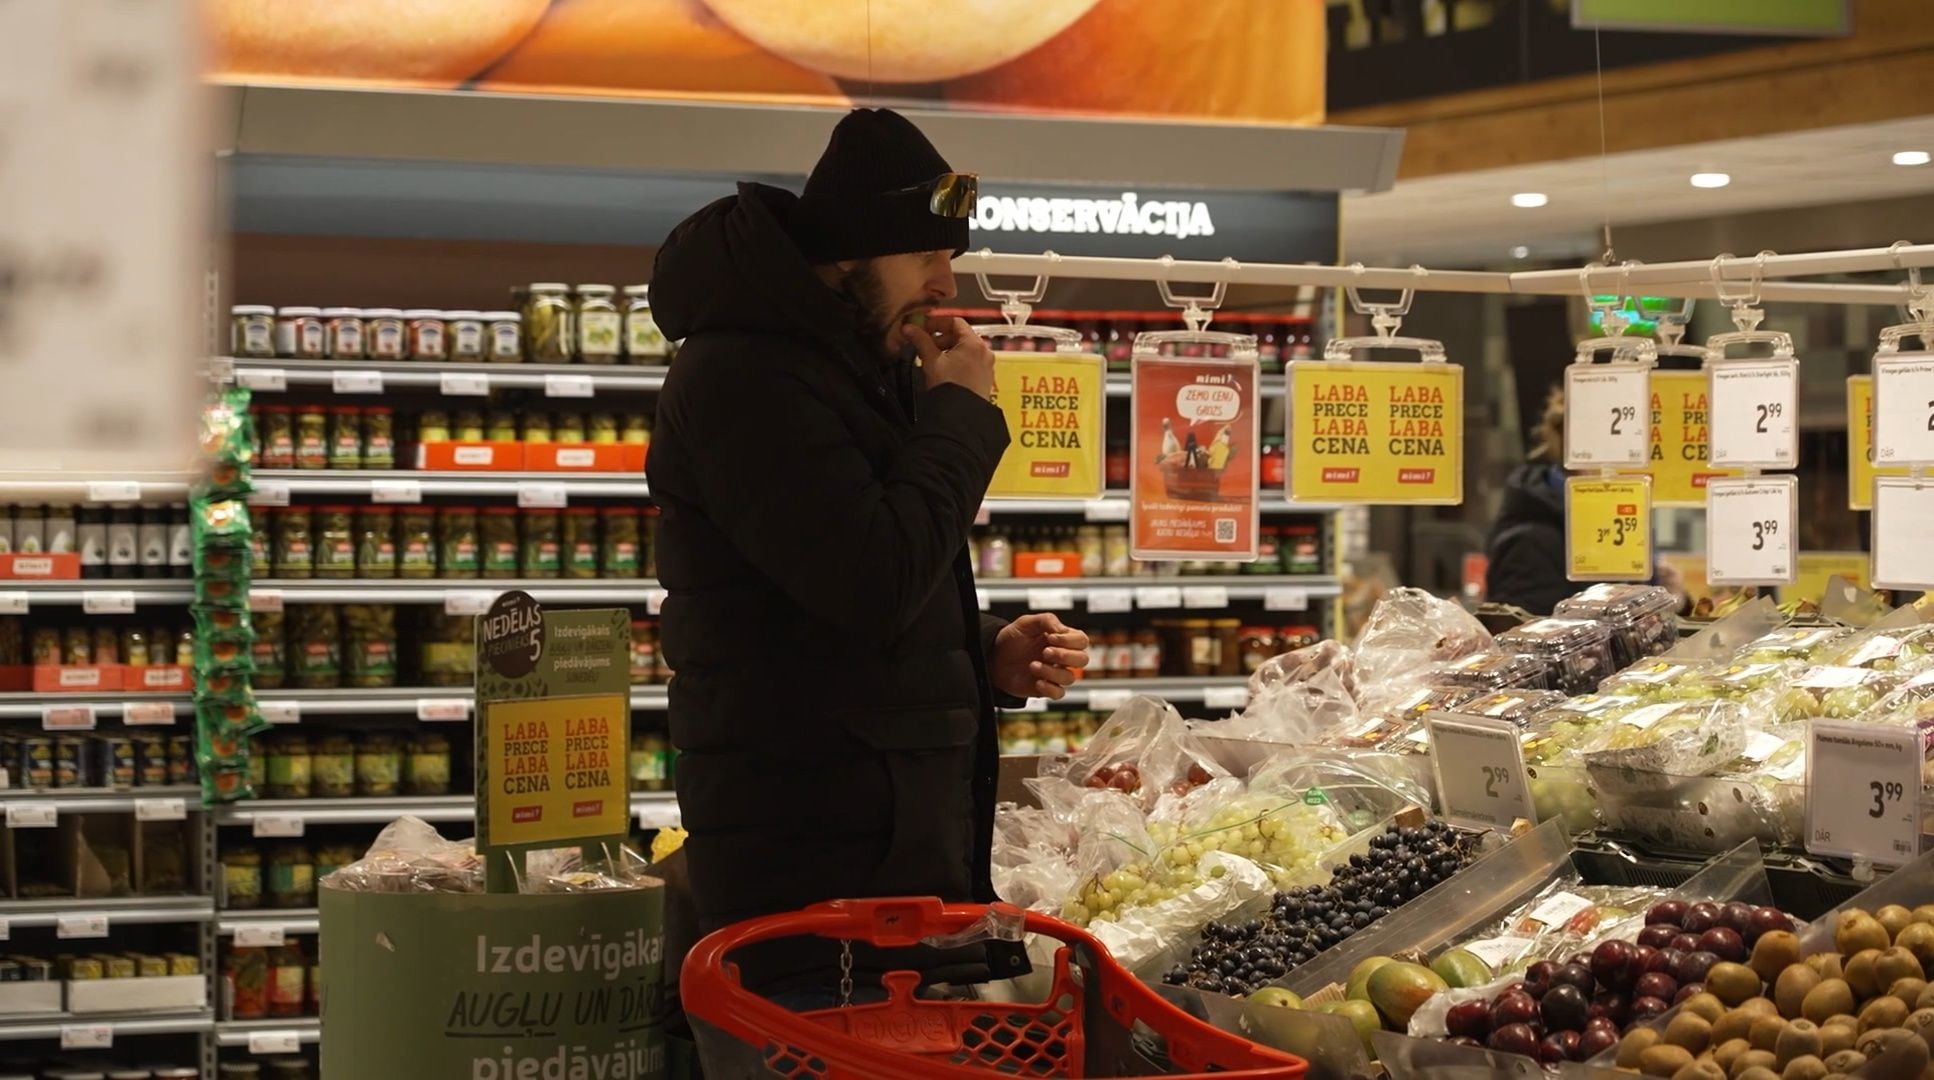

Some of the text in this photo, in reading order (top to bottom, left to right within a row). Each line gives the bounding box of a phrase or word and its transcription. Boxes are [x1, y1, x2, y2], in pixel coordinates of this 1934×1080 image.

[968, 192, 1215, 239] ONSERVĀCIJA
[1021, 376, 1079, 394] LABA
[1313, 384, 1368, 401] LABA
[1021, 395, 1079, 410] PRECE
[1389, 386, 1444, 403] LABA
[1683, 393, 1708, 410] LA
[1313, 403, 1368, 417] PRECE
[1389, 404, 1444, 418] PRECE
[1021, 411, 1079, 429] LABA
[1313, 418, 1368, 435] LABA
[1389, 420, 1444, 437] LABA
[1020, 431, 1081, 449] CENA
[1683, 426, 1708, 442] LA
[1312, 437, 1370, 454] CENA
[1388, 438, 1446, 455] CENA
[1681, 444, 1708, 461] CE
[483, 604, 541, 642] NEDĒĻAS
[529, 628, 541, 662] 5
[553, 655, 611, 672] piedāvājums
[504, 721, 548, 740] LABA
[565, 717, 609, 736] LABA
[504, 740, 548, 756] PRECE
[565, 736, 609, 751] PRECE
[504, 756, 548, 775] LABA
[565, 751, 609, 770] LABA
[503, 775, 550, 794] CENA
[564, 770, 611, 789] CENA
[476, 927, 665, 980] Izdevīgākai
[447, 990, 563, 1037] AUGĻU
[574, 985, 615, 1024] UN
[473, 1040, 665, 1080] piedāvājum
